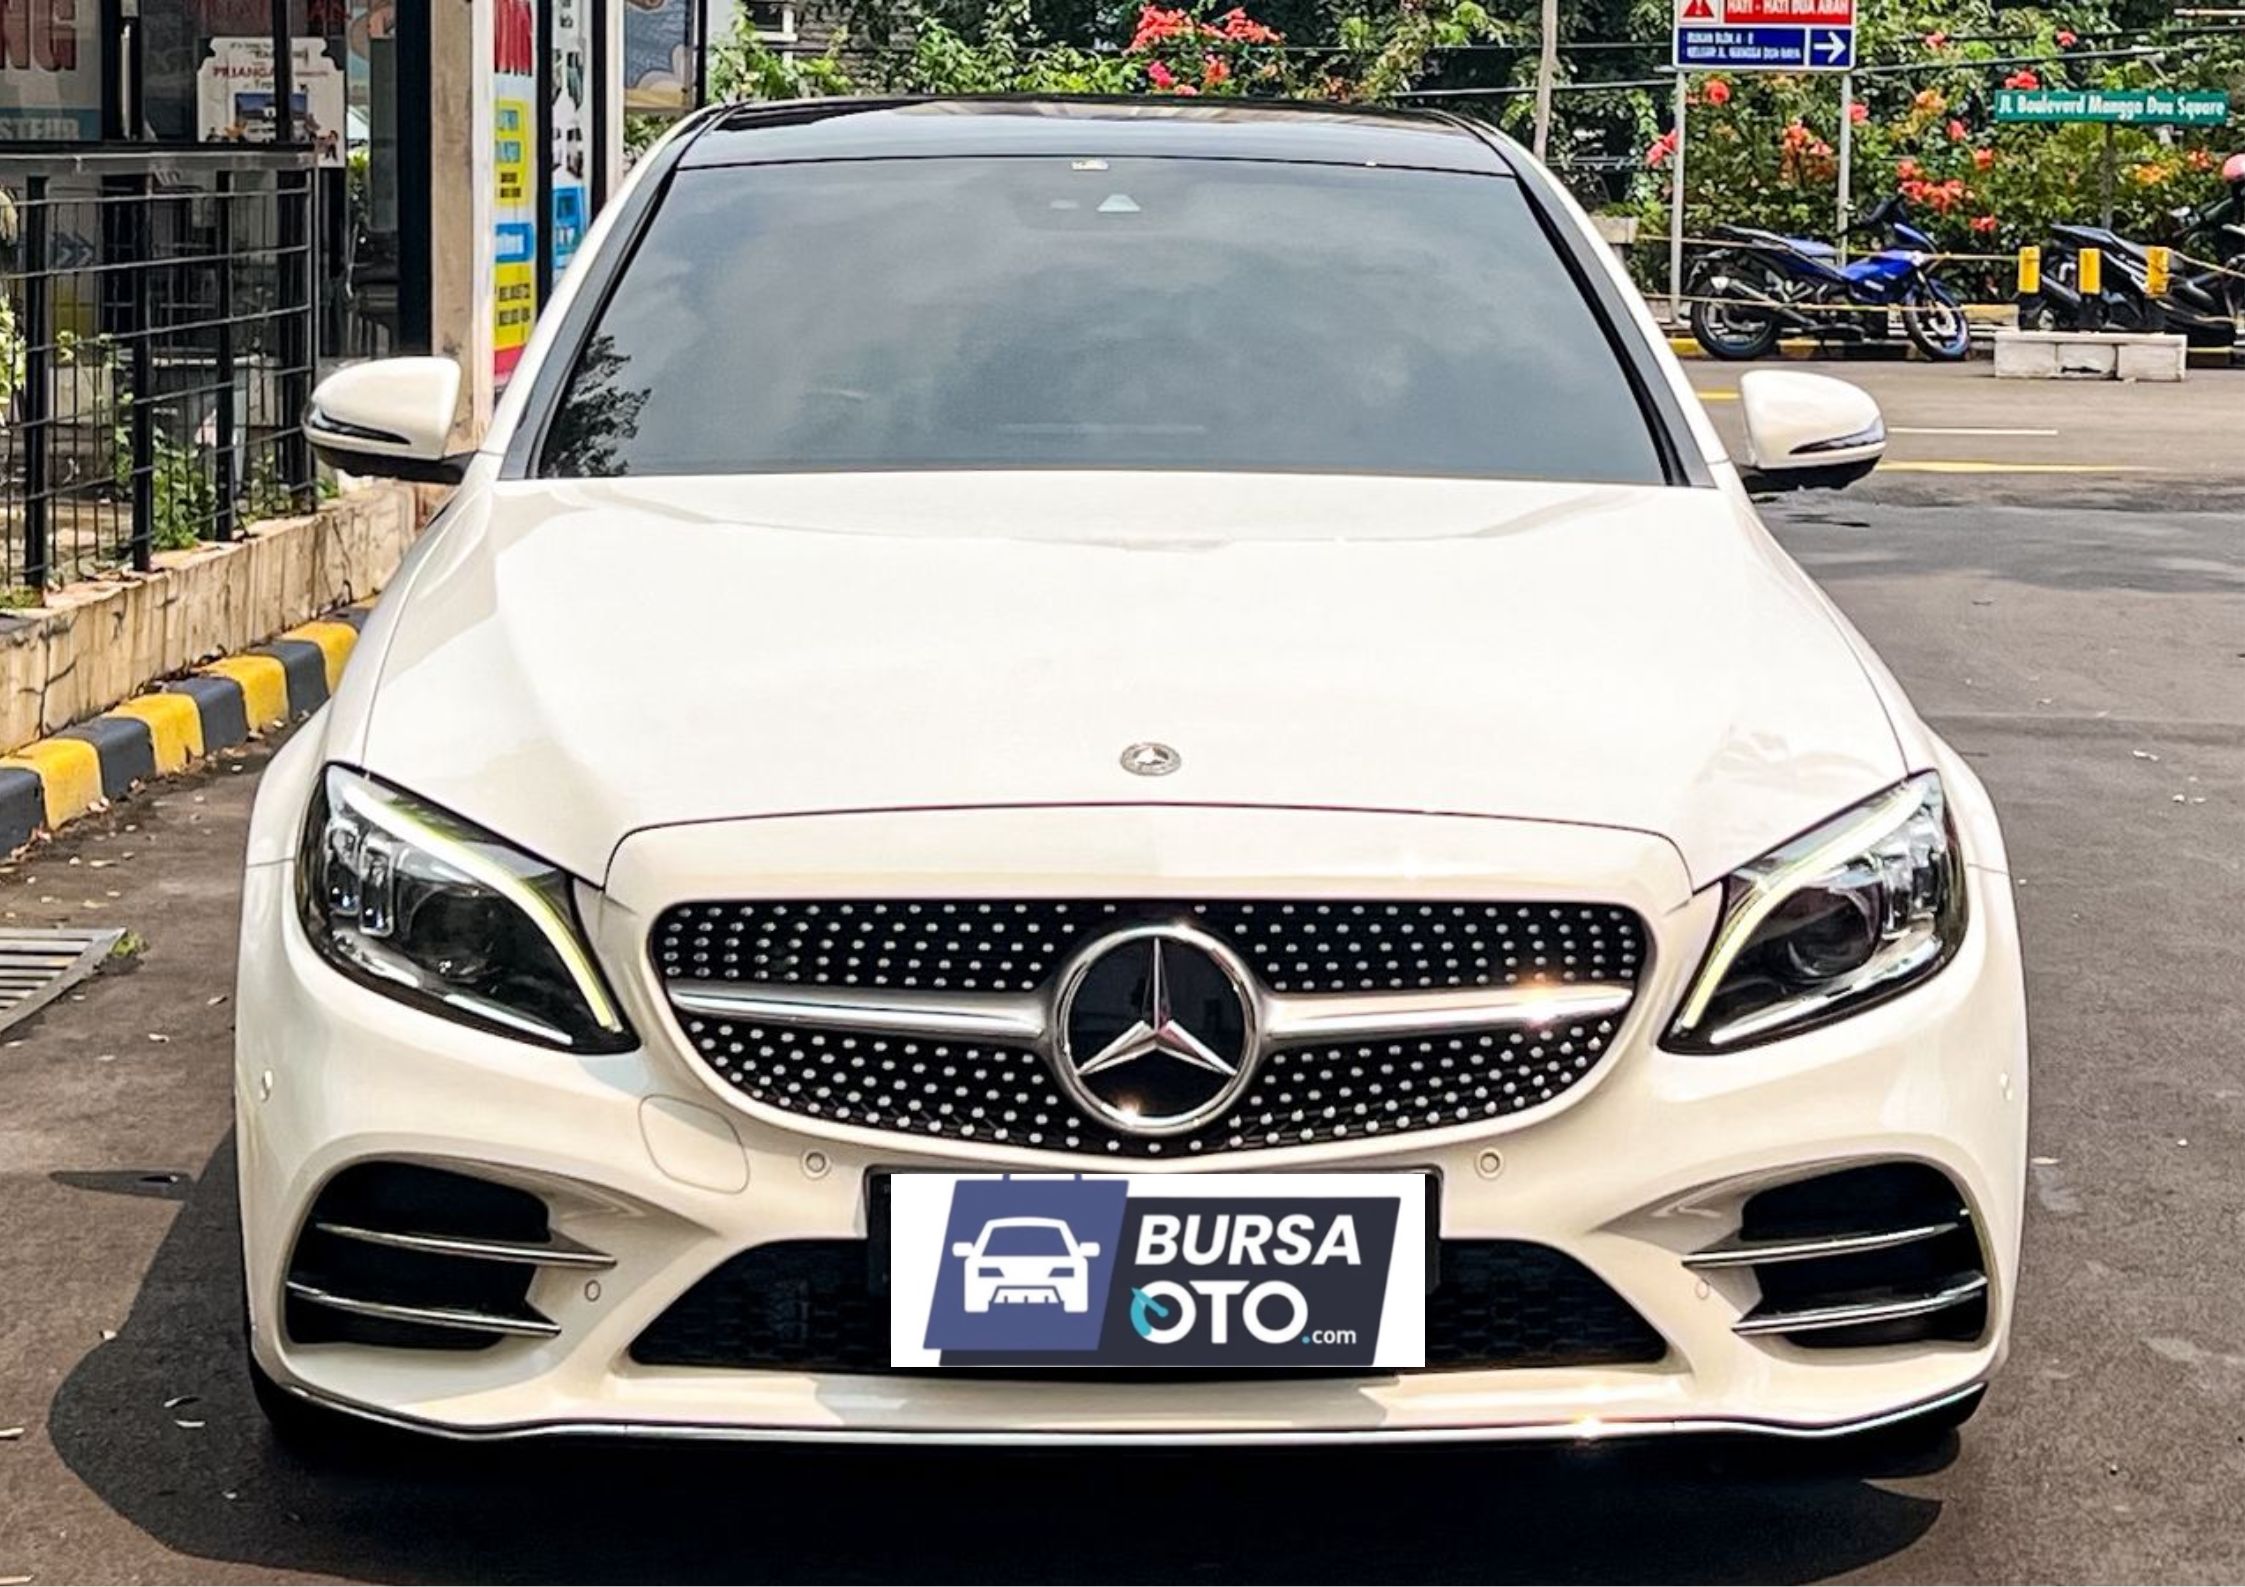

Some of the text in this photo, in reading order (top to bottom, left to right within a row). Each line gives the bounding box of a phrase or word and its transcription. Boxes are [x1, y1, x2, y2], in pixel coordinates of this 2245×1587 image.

[2016, 95, 2085, 114] Boulevard
[2088, 95, 2144, 120] Mangga
[2146, 97, 2174, 115] Dua
[2177, 97, 2225, 119] Square
